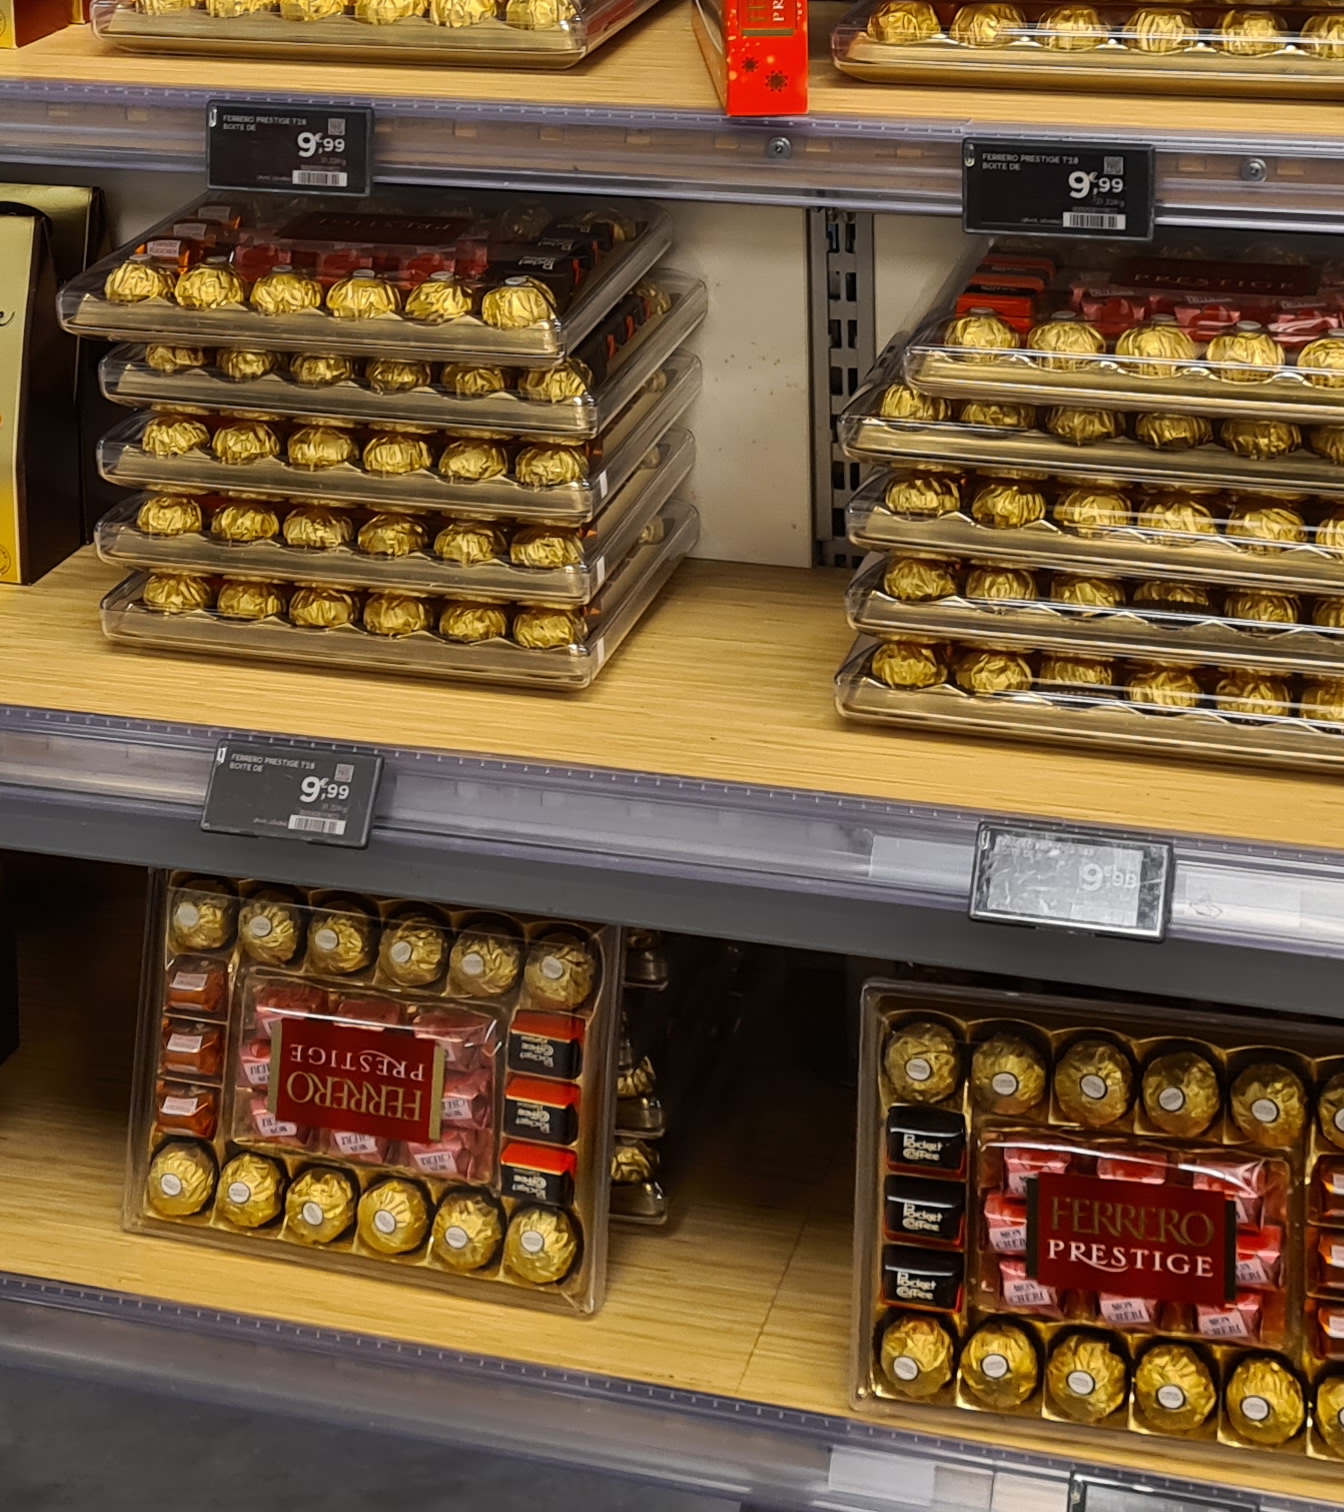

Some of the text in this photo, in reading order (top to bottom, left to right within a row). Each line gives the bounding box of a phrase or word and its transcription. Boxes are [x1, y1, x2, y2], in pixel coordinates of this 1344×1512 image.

[982, 153, 1018, 162] FERRERO
[1020, 155, 1059, 163] PRESTIGE
[291, 1043, 425, 1082] PRESTIGE
[286, 1071, 423, 1121] FERRERO
[1052, 1198, 1215, 1247] FERRERO
[1047, 1240, 1214, 1278] PRESTIGE
